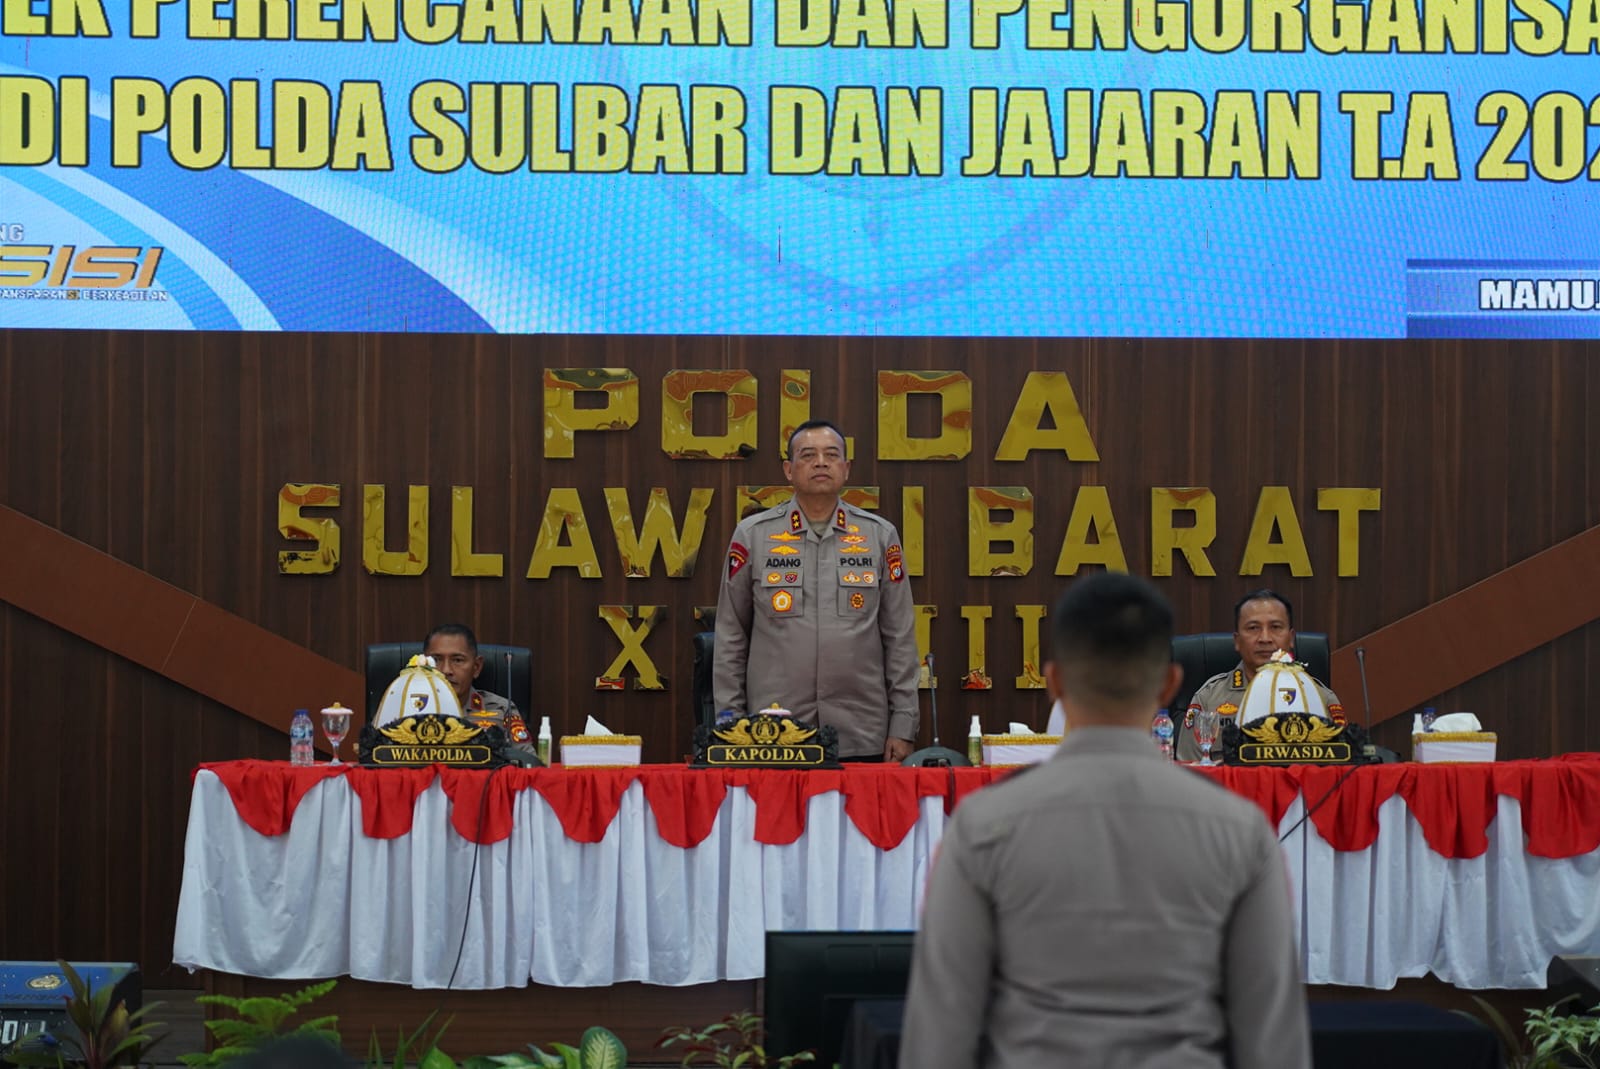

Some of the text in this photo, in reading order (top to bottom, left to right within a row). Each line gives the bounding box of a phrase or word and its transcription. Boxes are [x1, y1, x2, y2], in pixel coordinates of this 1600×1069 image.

[0, 75, 1600, 182] DI POLDA SULBAR DAN JAJARAN T.A 20
[1480, 279, 1600, 311] MAMU
[543, 367, 1100, 463] POLDA
[278, 484, 1381, 579] SULAWI BARAT
[766, 558, 801, 568] ADANG
[840, 557, 873, 567] POLRI
[391, 748, 473, 761] WAKAPOLDA
[725, 748, 806, 761] KAPOLDA
[1255, 746, 1336, 759] IRWASDA
